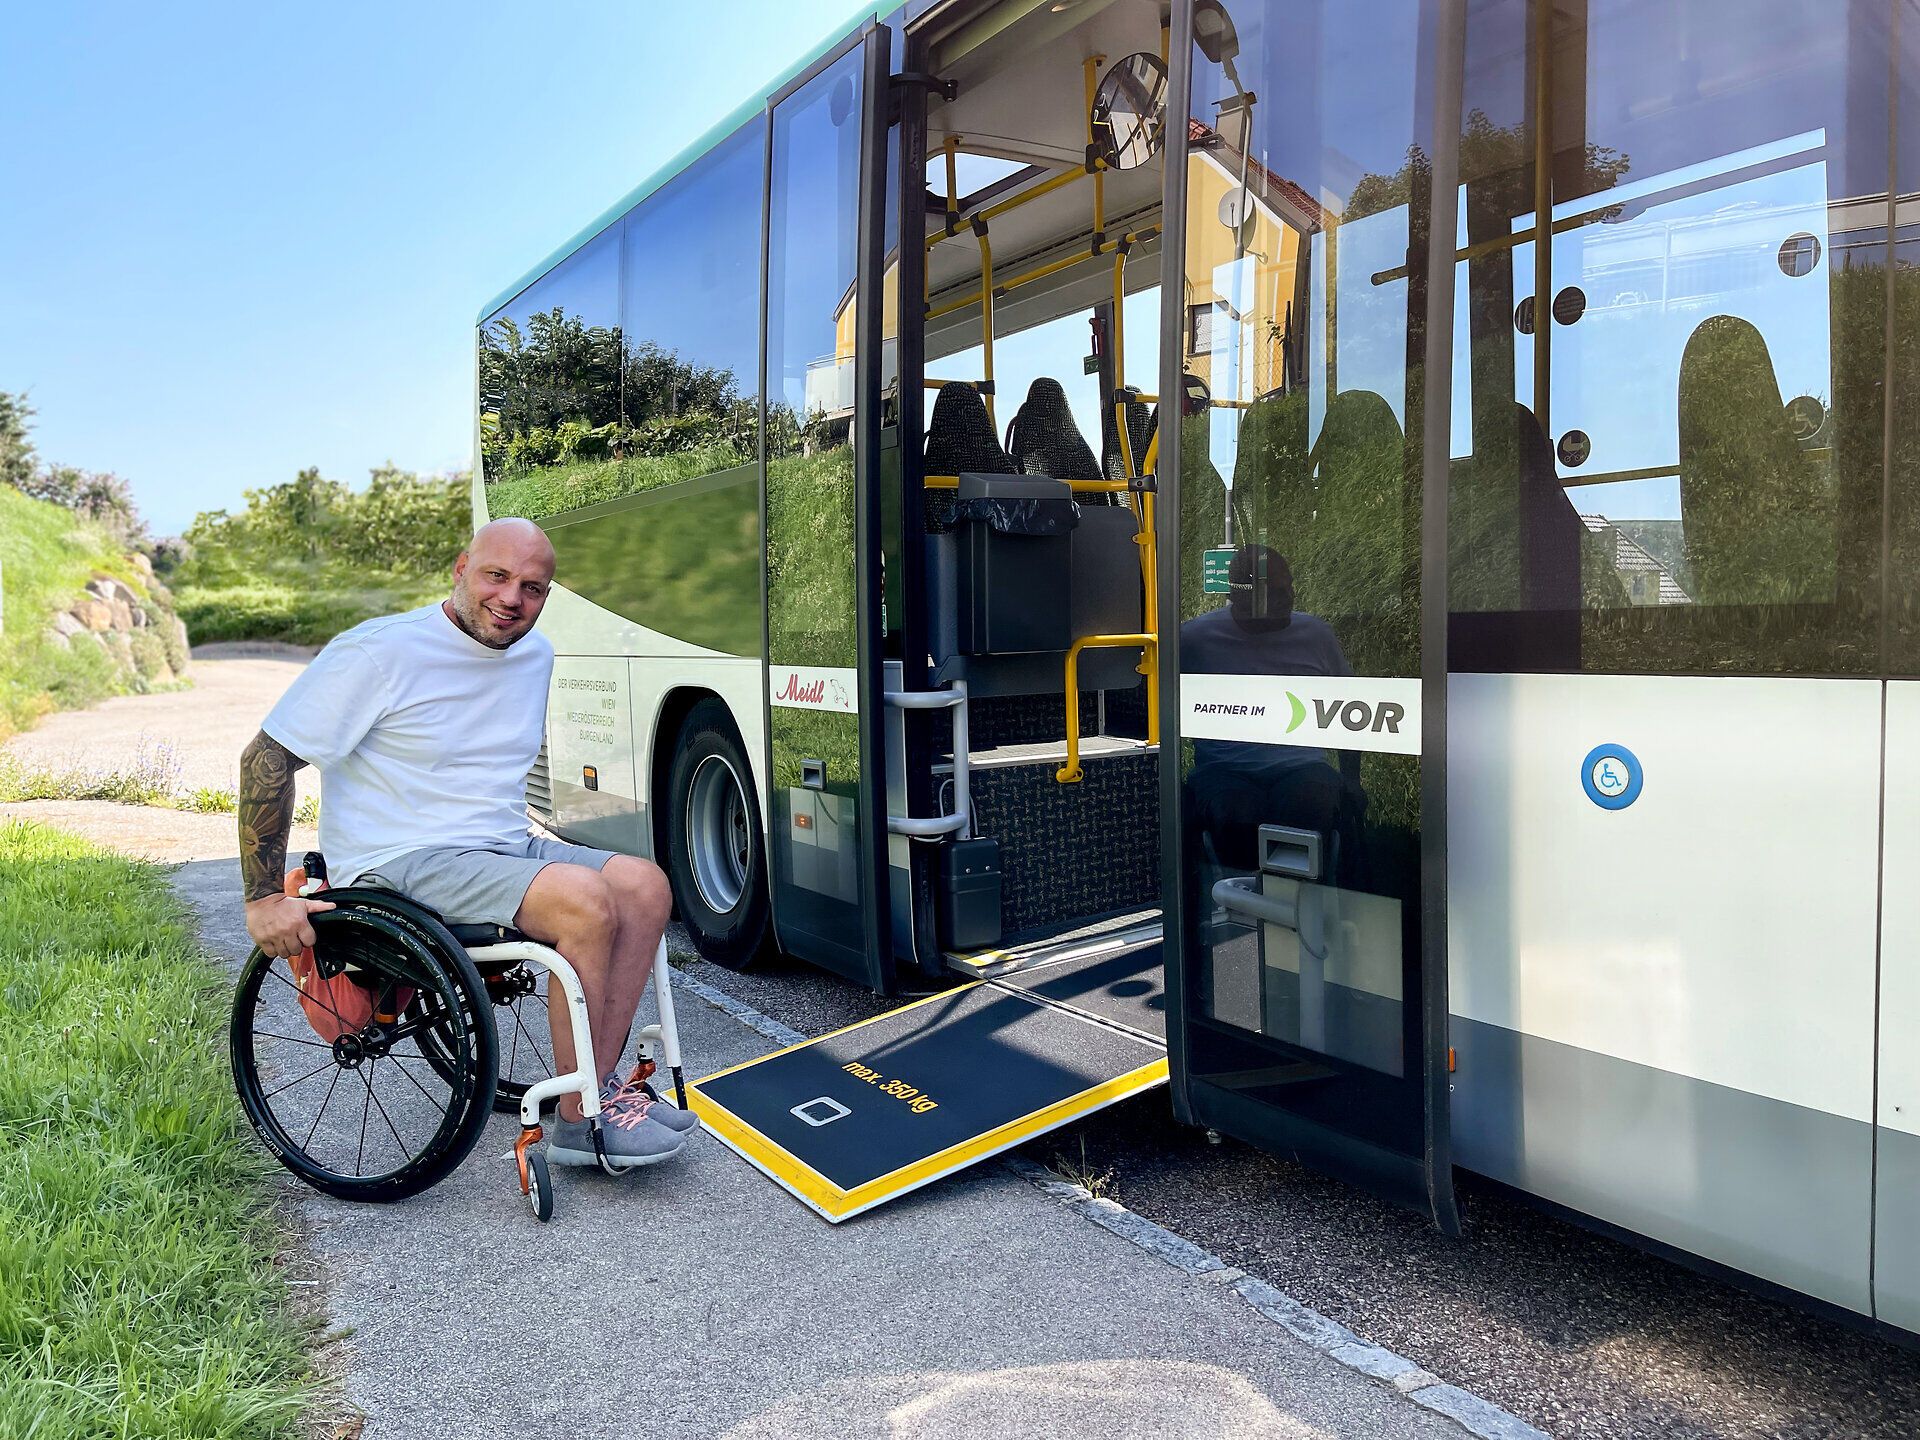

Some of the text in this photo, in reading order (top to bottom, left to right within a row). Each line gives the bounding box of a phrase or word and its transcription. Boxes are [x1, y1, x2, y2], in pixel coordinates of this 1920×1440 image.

[776, 673, 824, 703] Meidl
[1194, 703, 1266, 716] PARTNER IM
[1312, 699, 1405, 734] VOR
[841, 1062, 939, 1114] max. 350 kg
